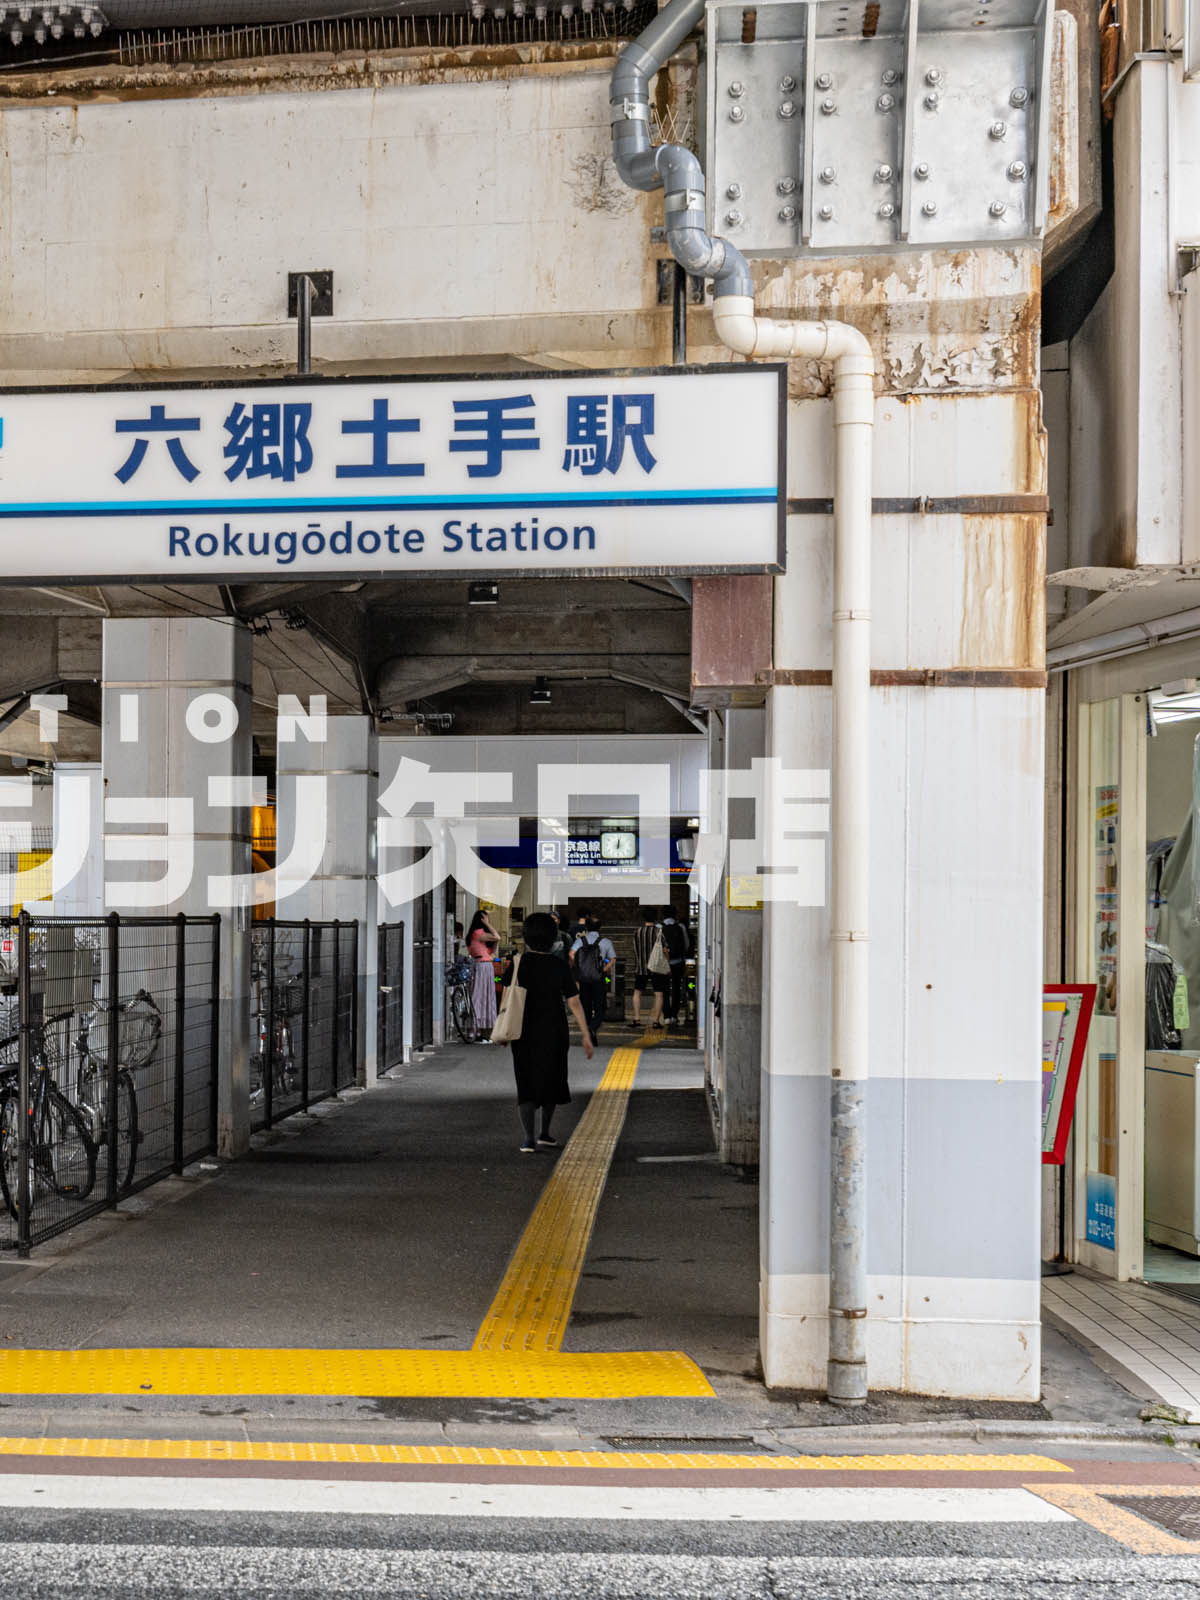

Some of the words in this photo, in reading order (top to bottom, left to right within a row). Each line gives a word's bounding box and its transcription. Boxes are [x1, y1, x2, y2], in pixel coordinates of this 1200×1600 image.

[114, 393, 658, 483] 六郷土手駅
[167, 518, 426, 564] Rokugōdote
[443, 516, 597, 553] Station
